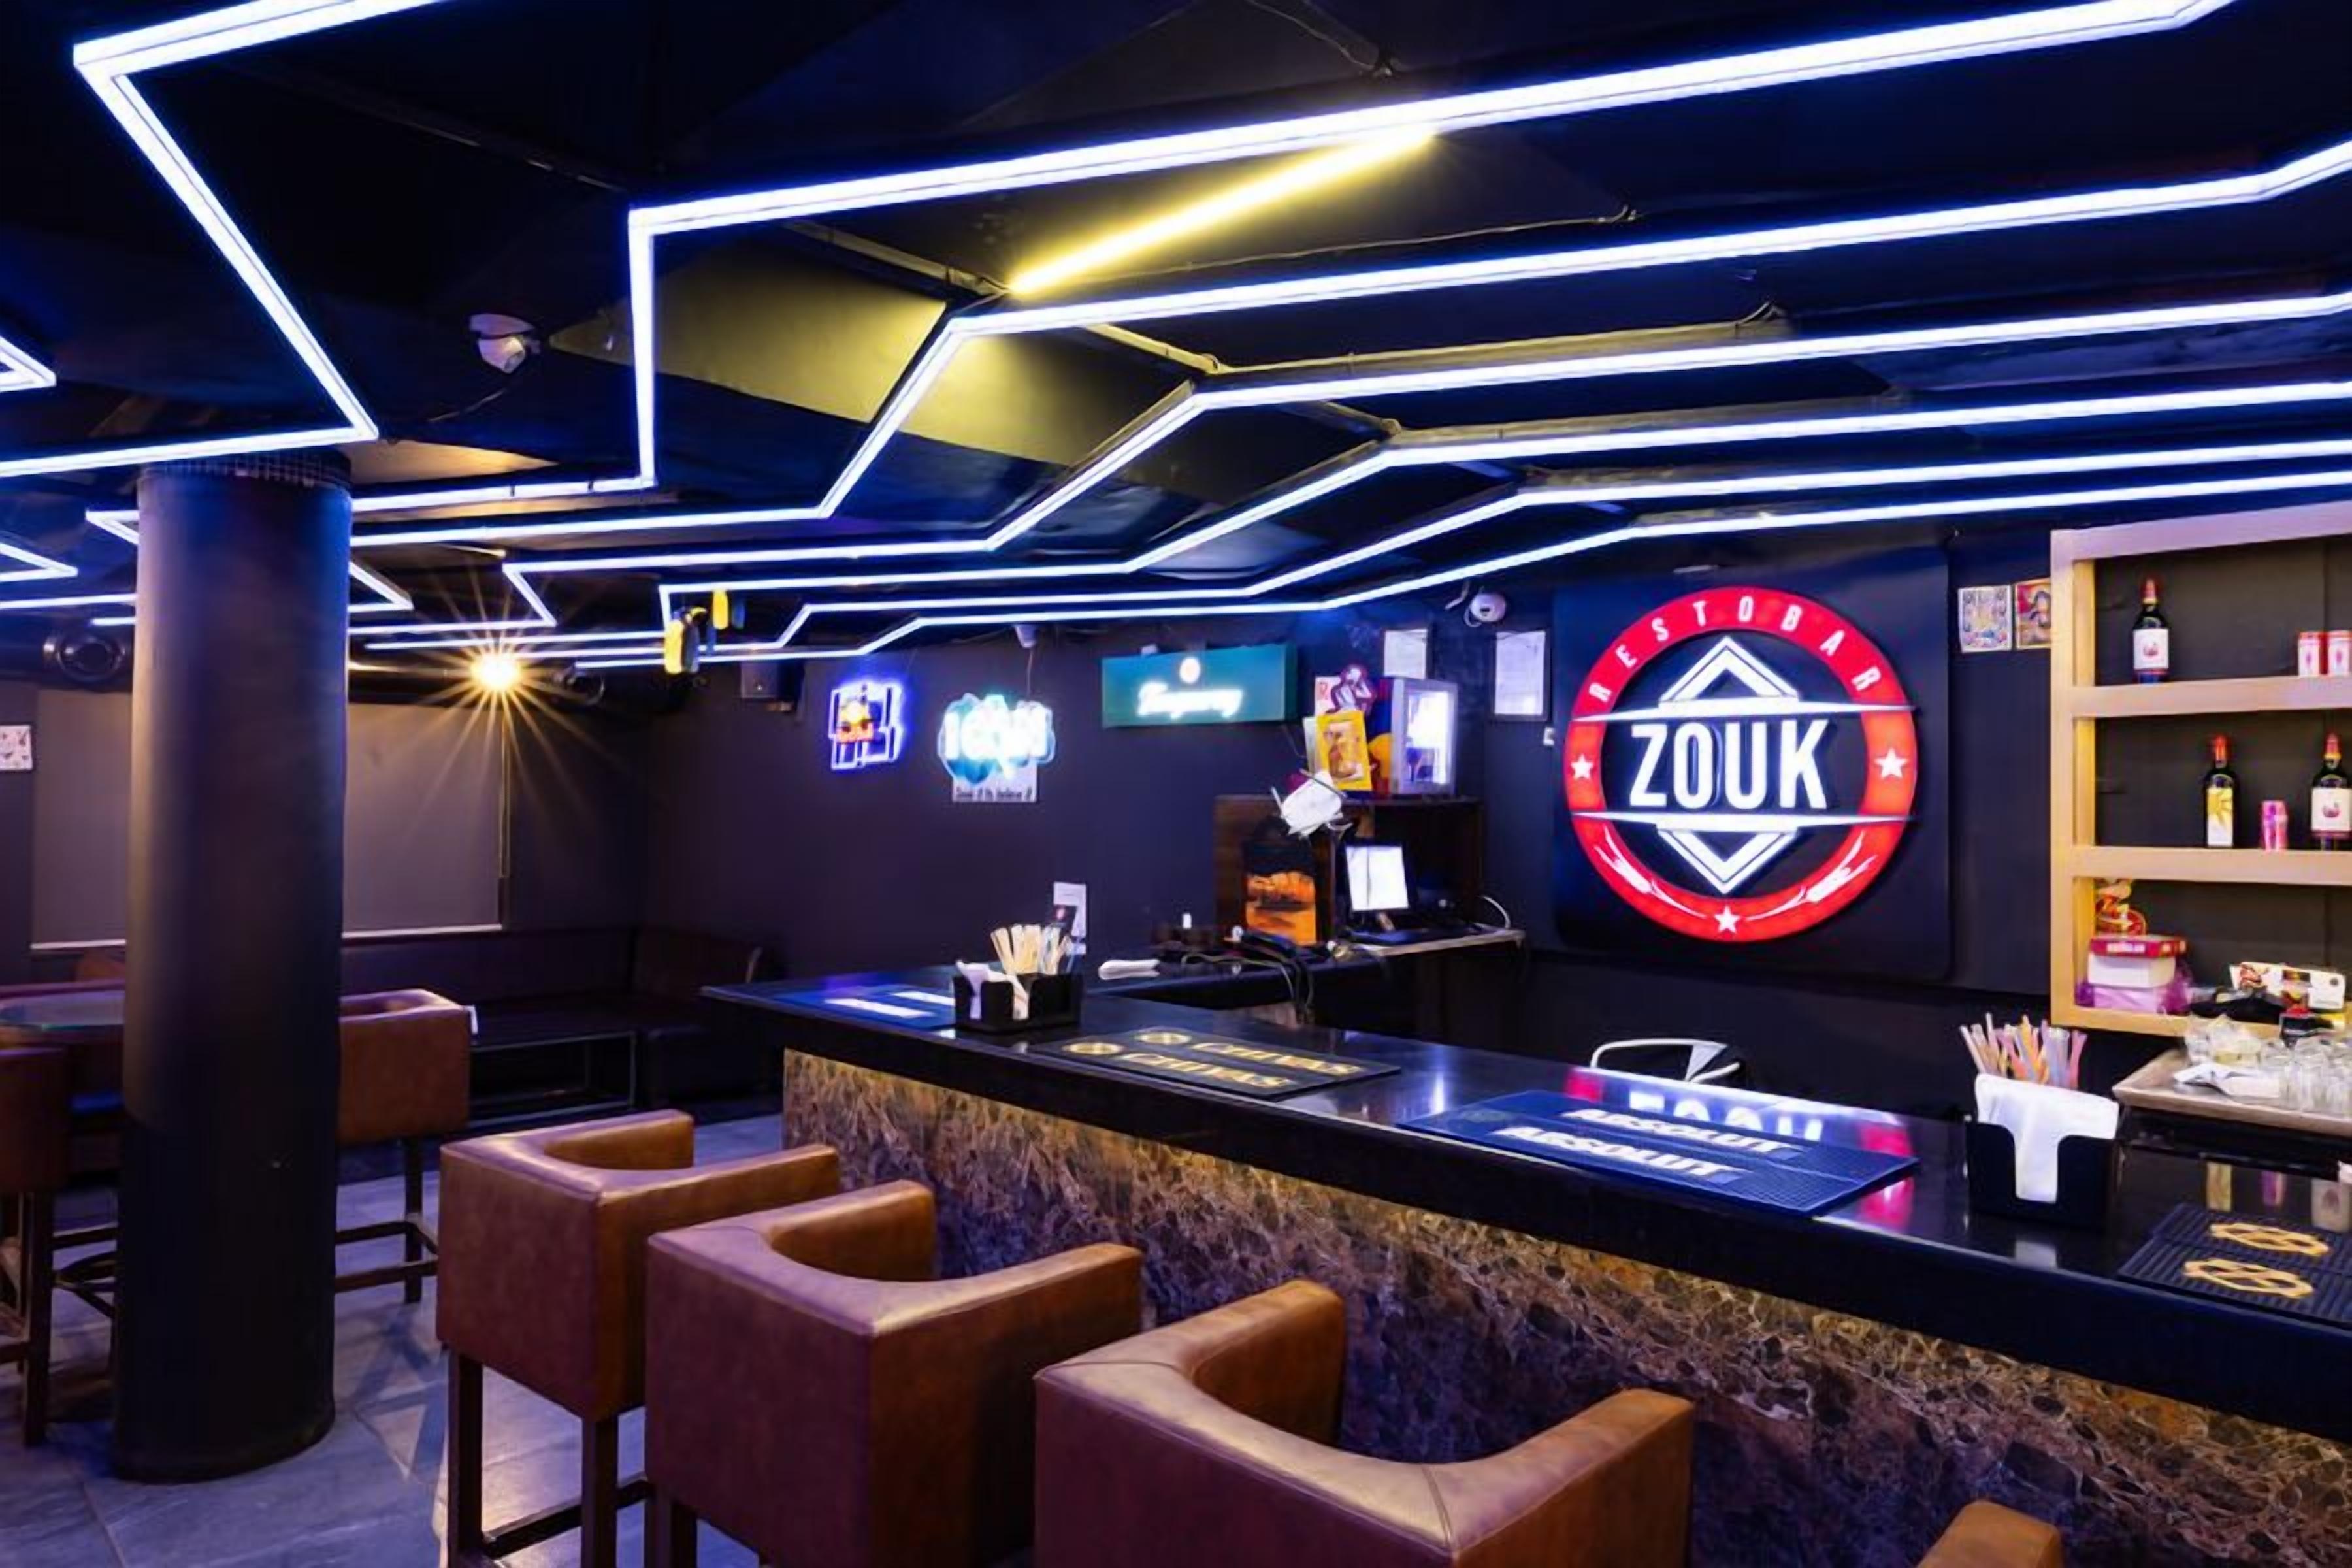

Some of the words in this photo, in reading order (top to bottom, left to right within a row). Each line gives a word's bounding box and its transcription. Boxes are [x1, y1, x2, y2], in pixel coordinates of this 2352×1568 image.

[1589, 595, 1882, 702] RESTOBAR
[1629, 719, 1829, 809] ZOUK
[1492, 1126, 1754, 1177] ABSOLUT
[1561, 1108, 1807, 1154] ABSOLUT
